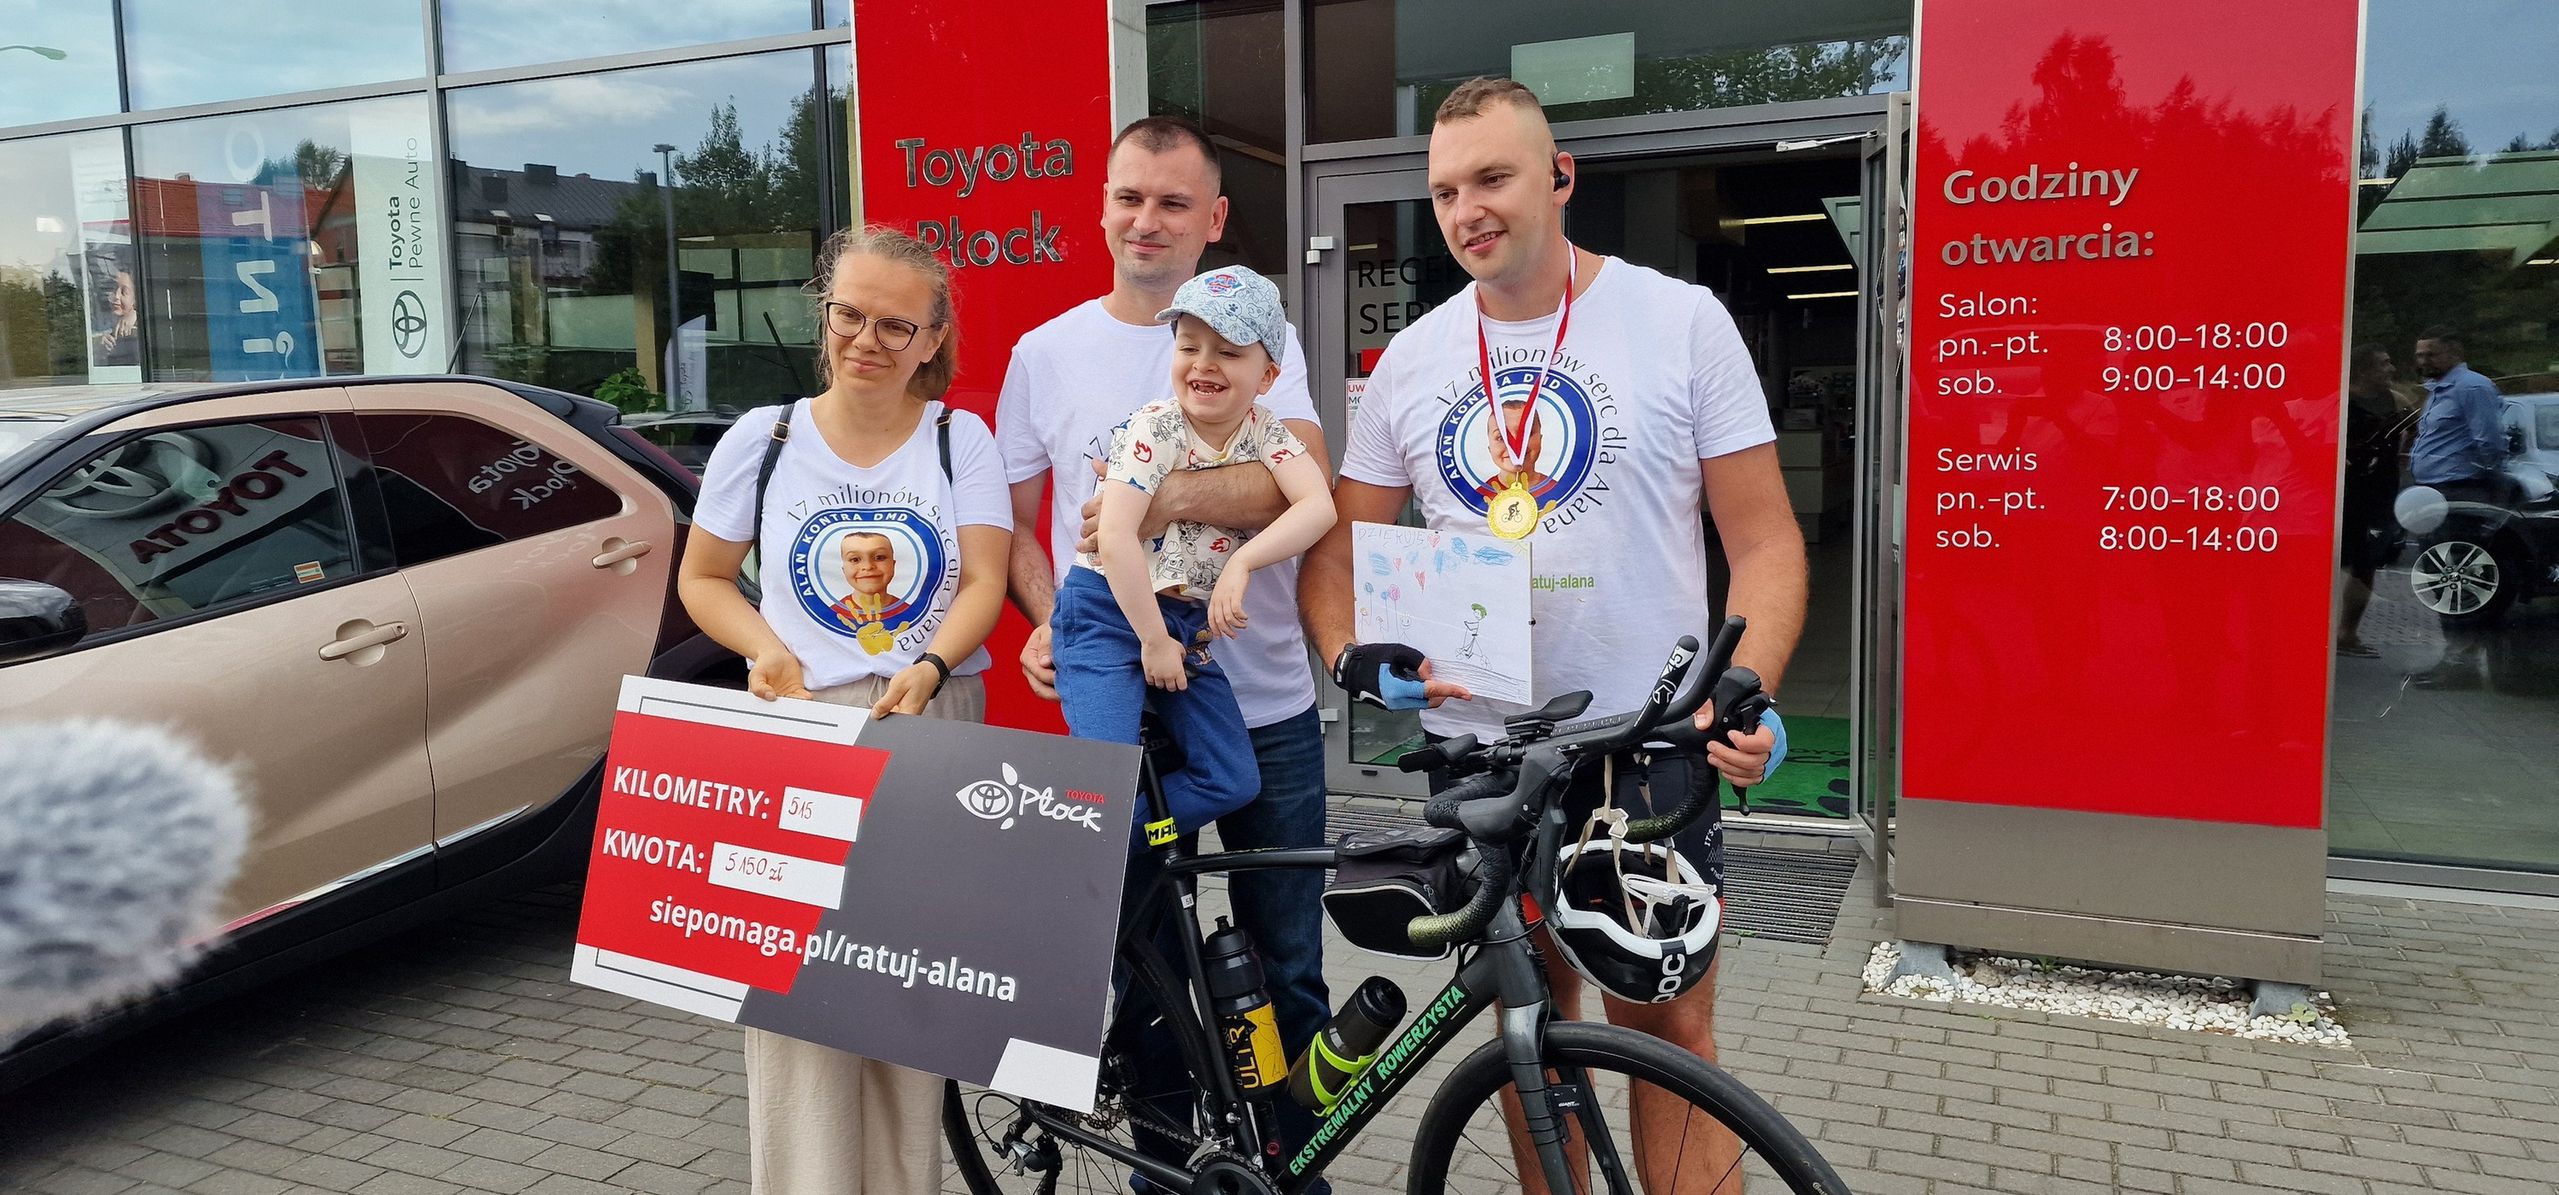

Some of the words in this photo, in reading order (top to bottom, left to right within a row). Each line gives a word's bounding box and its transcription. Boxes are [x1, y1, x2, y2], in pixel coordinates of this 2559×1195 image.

[405, 136, 420, 190] Auto
[896, 131, 1073, 198] Toyota
[1943, 161, 2140, 207] Godziny
[389, 195, 405, 270] Toyota
[408, 196, 424, 269] Pewne
[917, 210, 1063, 268] Płock
[1941, 222, 2154, 266] otwarcia:
[1938, 290, 2038, 319] Salon:
[1938, 330, 2049, 363] pn.-pt.
[2103, 321, 2288, 352] 8:00-18:00
[1435, 380, 1460, 406] 17
[1451, 375, 1512, 426] KONTA
[1582, 372, 1618, 419] serc
[1937, 369, 2003, 396] sob.
[2101, 362, 2286, 392] 9:00-14:00
[1442, 435, 1461, 480] ALAN
[1599, 426, 1628, 466] dla
[1936, 446, 2038, 472] Serwis
[873, 512, 909, 522] DMD
[1541, 472, 1611, 535] Alana
[1935, 486, 2046, 516] pn.-pt.
[2101, 485, 2281, 512] 7:00-18:00
[802, 512, 863, 545] KONTRA
[1935, 522, 2001, 549] sob.
[2099, 524, 2279, 552] 8:00-14:00
[787, 499, 809, 522] 17
[817, 482, 928, 507] milionów
[896, 596, 946, 653] Alana
[795, 552, 815, 598] ALAN
[613, 765, 771, 820] KILOMETRY:
[788, 796, 814, 820] 515
[1018, 783, 1102, 833] Płock
[1065, 788, 1106, 804] TOYOTA
[602, 827, 705, 874] KWOTA:
[648, 895, 1017, 1003] siepomaga.pl/ratuj-alana
[1288, 1077, 1375, 1177] EKSTREMALNY
[1375, 984, 1466, 1081] ROWERZYSTA
